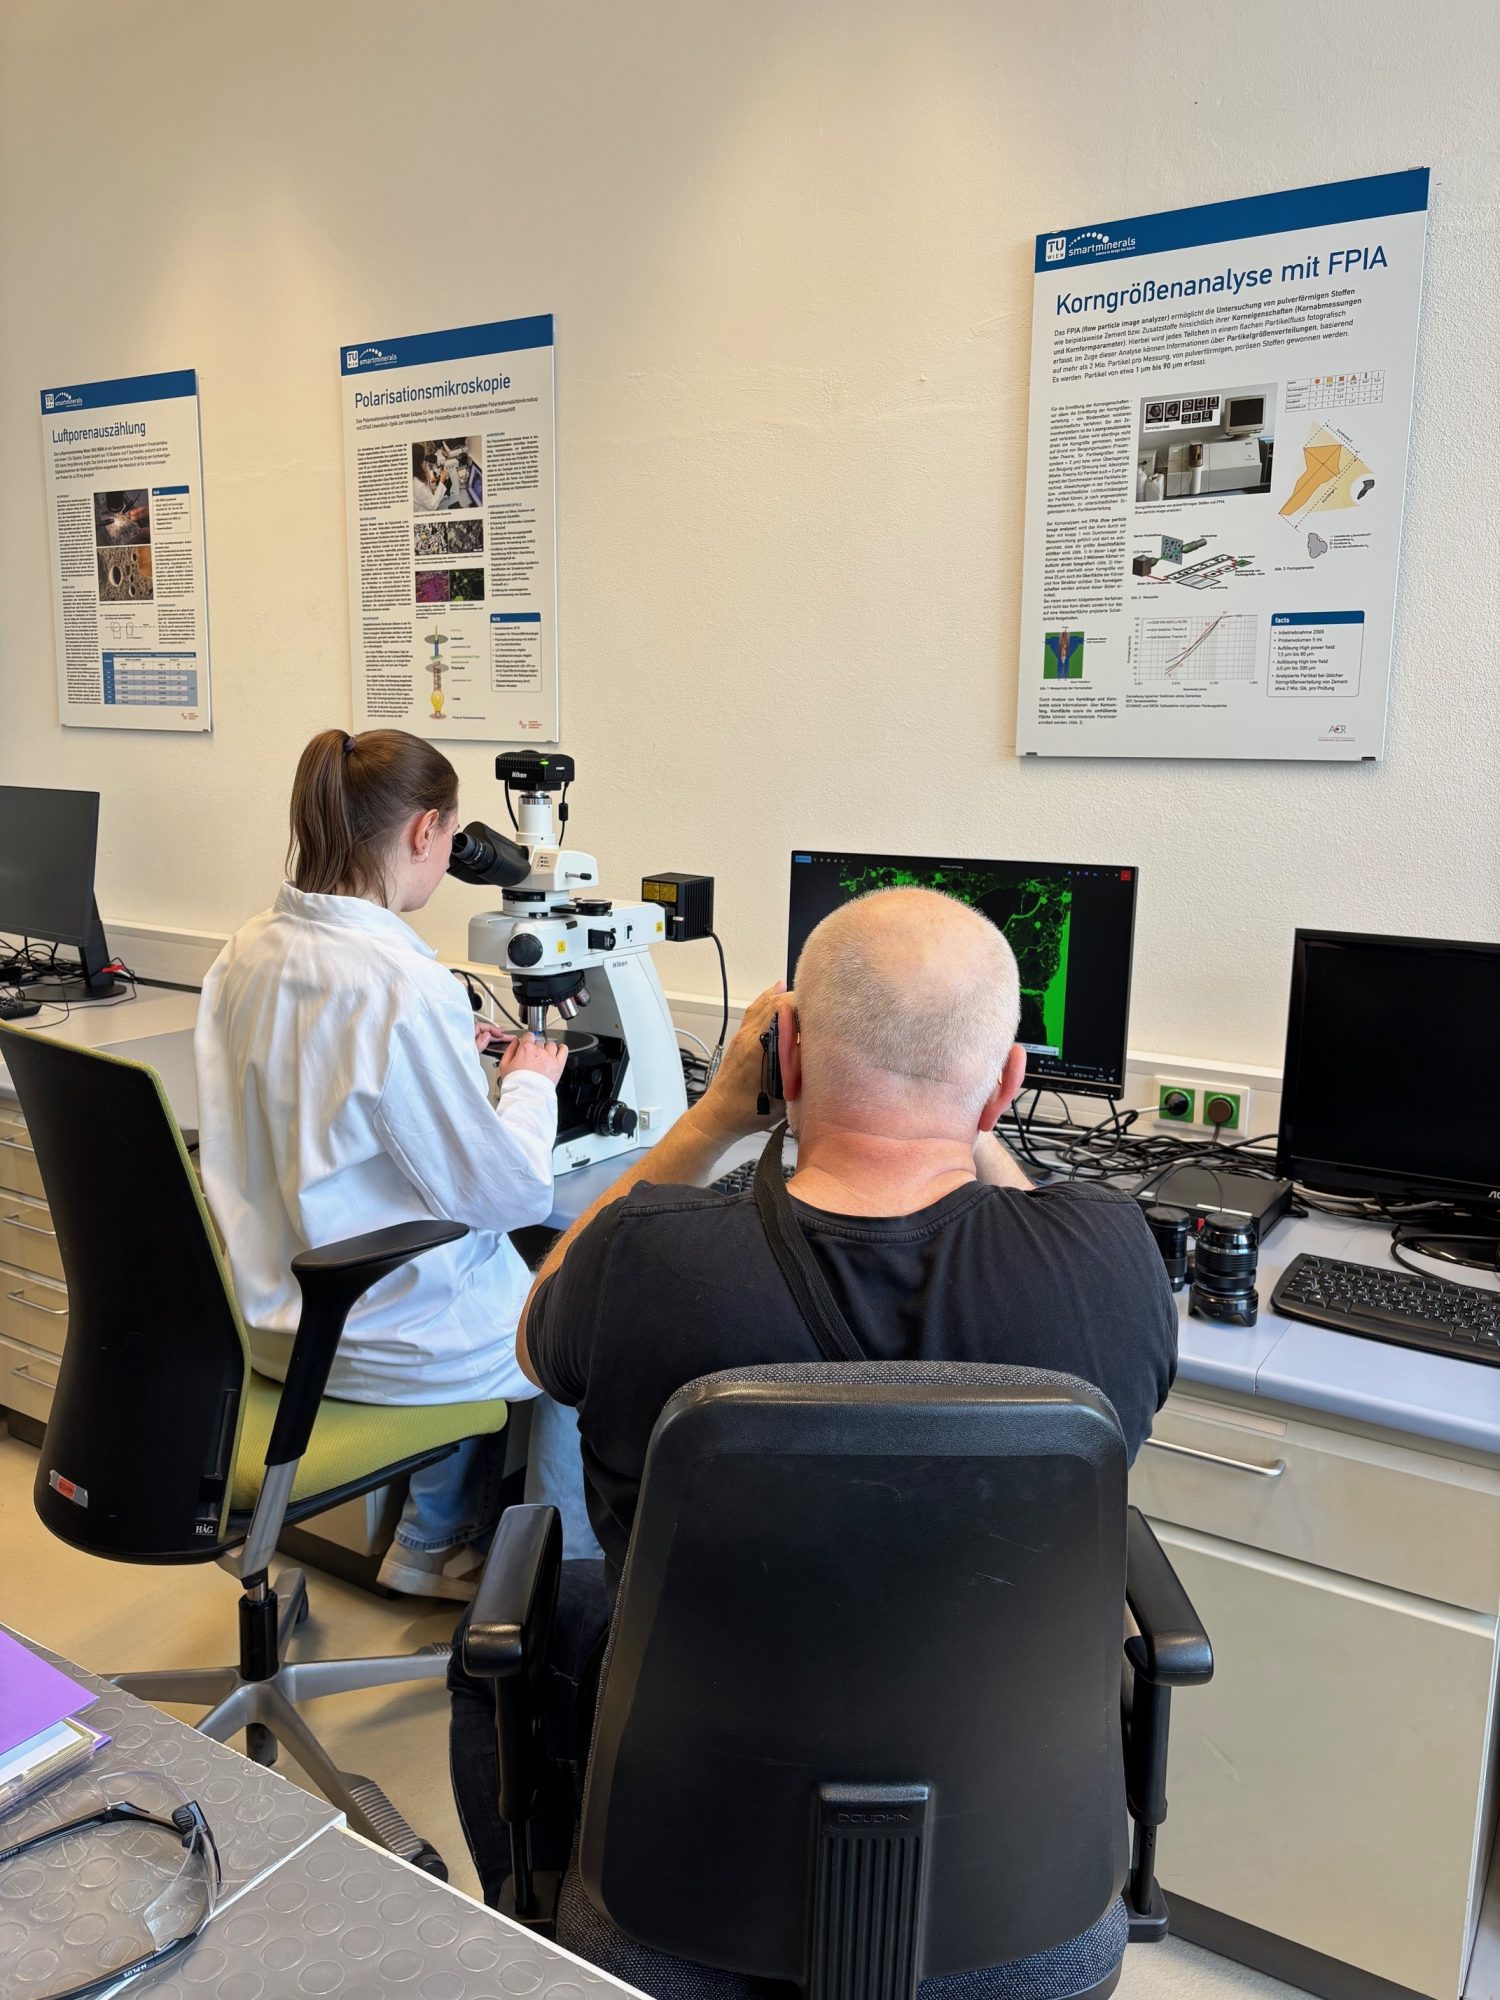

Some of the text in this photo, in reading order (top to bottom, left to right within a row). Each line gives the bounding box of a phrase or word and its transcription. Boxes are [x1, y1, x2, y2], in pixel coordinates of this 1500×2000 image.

[1047, 238, 1065, 254] TU
[1068, 236, 1136, 256] smartminerals
[1056, 245, 1387, 315] Korngrößenanalyse mit FPIA
[1097, 321, 1120, 331] particle
[1121, 319, 1140, 327] image
[1141, 314, 1170, 324] analyzer)
[1171, 309, 1204, 320] ermöglicht
[1216, 302, 1262, 313] Untersuchung
[1276, 292, 1329, 306] pulverförmigen
[1331, 288, 1355, 297] Stoffen
[1104, 330, 1126, 339] Zement
[1142, 323, 1177, 333] Zusatzstoffe
[1179, 318, 1213, 328] hinsichtlich
[1232, 307, 1293, 321] Korneigenschaften
[1294, 298, 1361, 313] (Kornabmessungen
[1118, 348, 1141, 356] Analyse
[1166, 339, 1209, 349] Informationen
[1320, 319, 1353, 329] basierend
[1128, 337, 1150, 345] Hierbei
[1165, 332, 1182, 341] jedes
[1183, 329, 1209, 337] Teilchen
[1218, 325, 1238, 333] einem
[1239, 319, 1263, 330] flachen
[1264, 316, 1305, 326] Partikelfluss
[1307, 310, 1346, 321] fotografisch
[1053, 366, 1062, 374] auf
[1089, 360, 1093, 369] 2
[1107, 358, 1130, 366] Partikel
[1235, 342, 1261, 352] porösen
[1262, 338, 1284, 347] Stoffen
[1286, 334, 1320, 345] gewonnen
[1084, 370, 1107, 378] Partikel
[1119, 365, 1134, 374] etwa
[1162, 360, 1171, 369] 90
[355, 373, 510, 408] Polarisationsmikroskopie
[52, 421, 146, 444] Luftporenauszählung
[195, 1524, 215, 1534] HÅG
